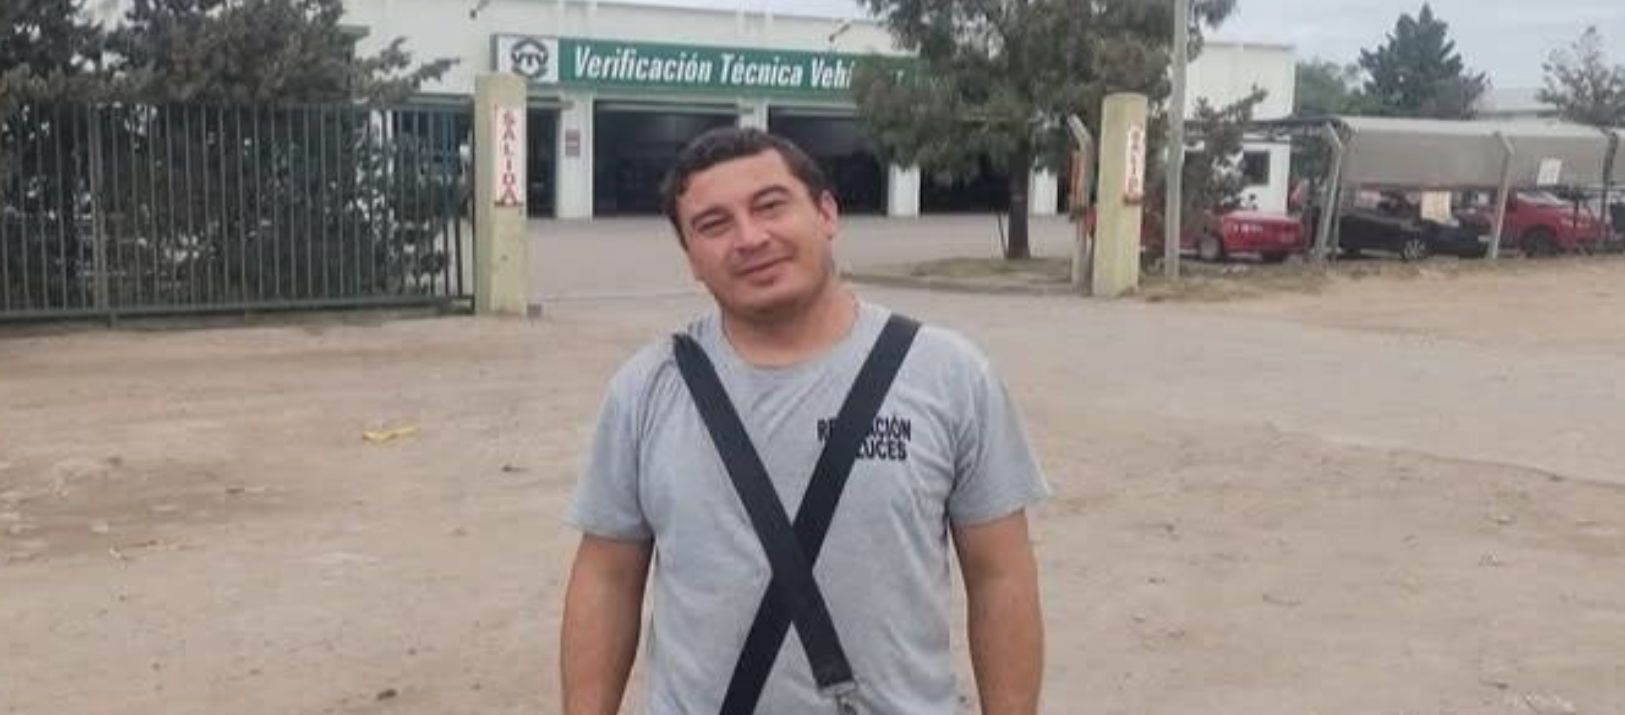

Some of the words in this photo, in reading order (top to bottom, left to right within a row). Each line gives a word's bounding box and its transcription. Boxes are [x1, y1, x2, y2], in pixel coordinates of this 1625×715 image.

[574, 46, 713, 84] Verificación
[720, 53, 803, 86] Técnica
[502, 110, 518, 205] SALIDA
